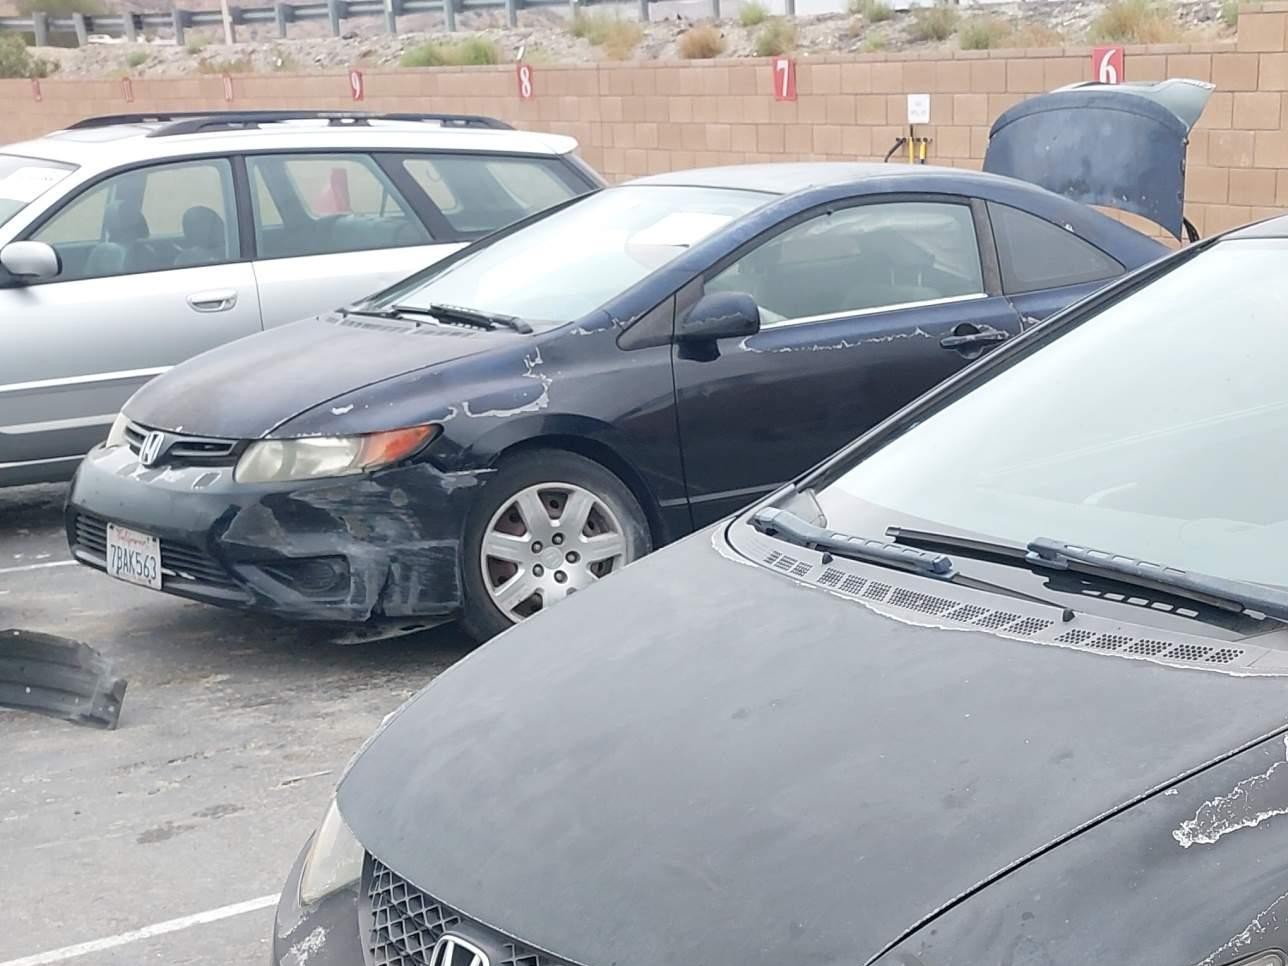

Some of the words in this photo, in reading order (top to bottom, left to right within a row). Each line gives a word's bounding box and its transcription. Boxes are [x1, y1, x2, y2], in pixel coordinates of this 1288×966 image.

[520, 66, 531, 97] 8
[776, 60, 789, 97] 7
[1100, 49, 1117, 84] 6
[351, 71, 360, 98] 9
[110, 543, 157, 580] 7BAK563
